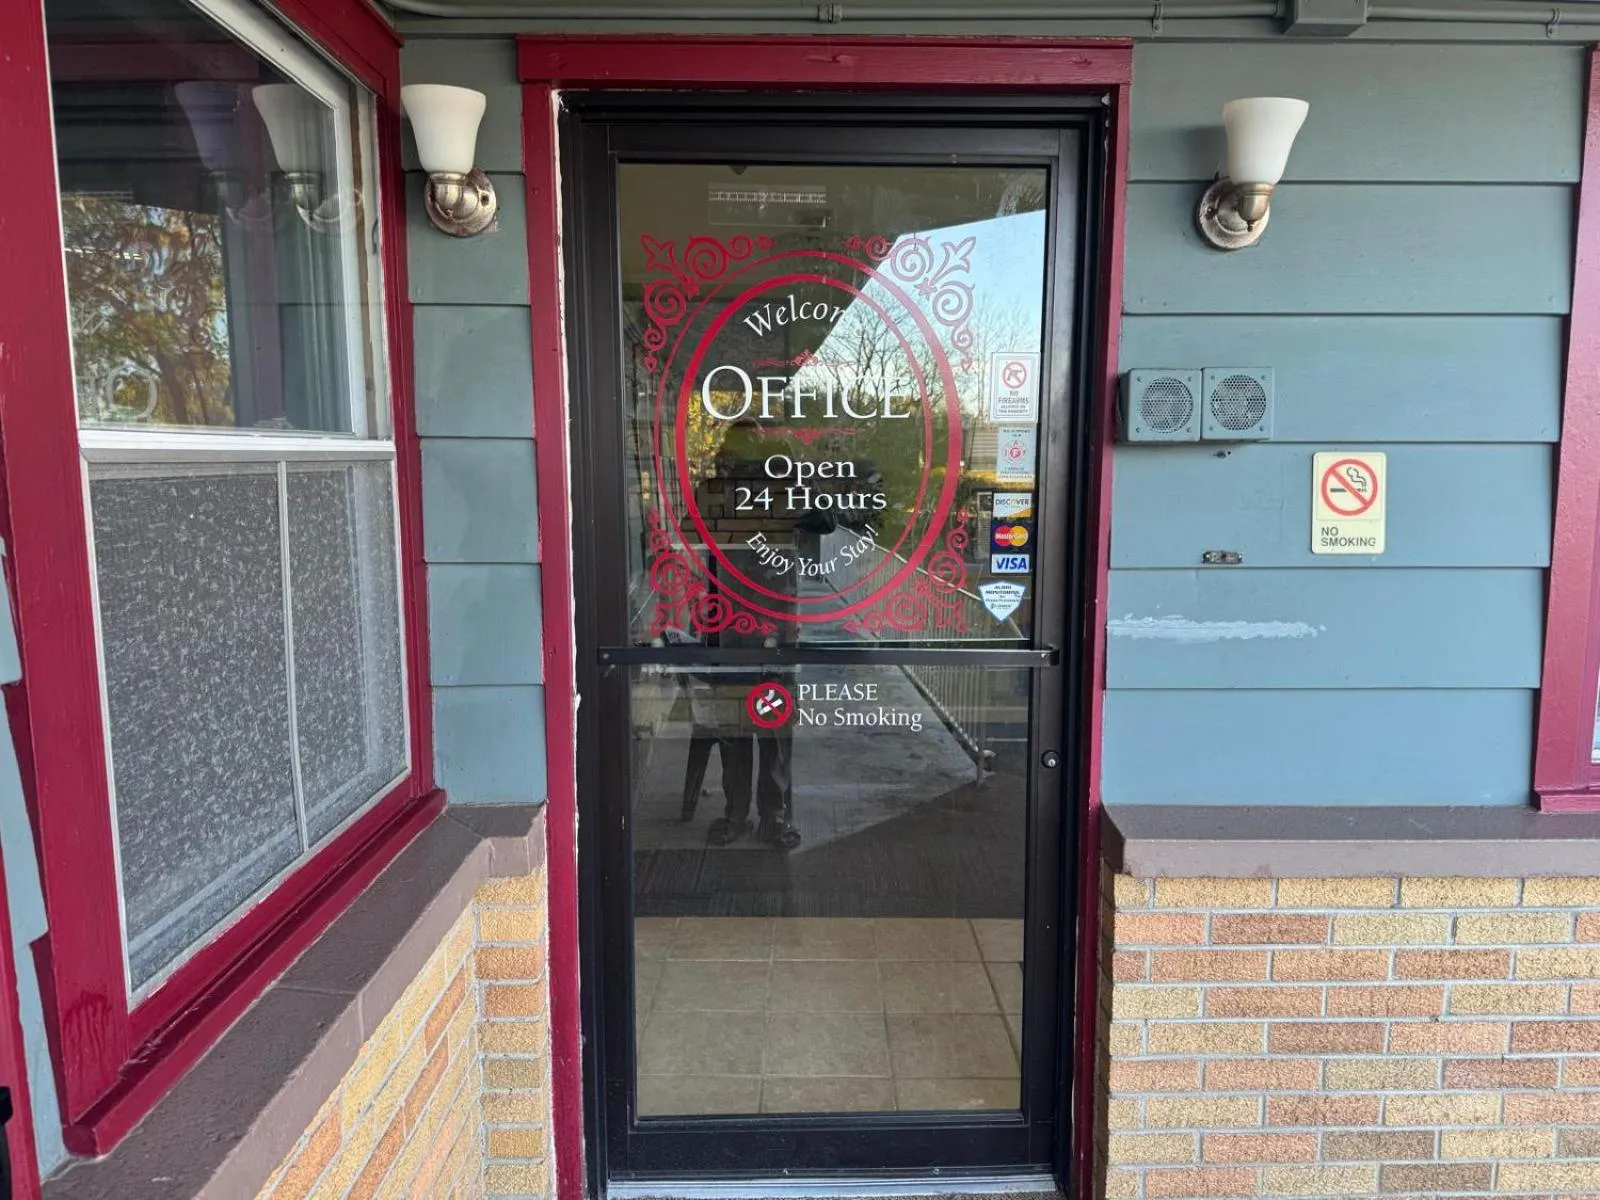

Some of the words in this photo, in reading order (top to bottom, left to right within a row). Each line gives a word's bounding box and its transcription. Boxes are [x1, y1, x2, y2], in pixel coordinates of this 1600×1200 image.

[743, 294, 848, 337] Welco
[702, 365, 910, 420] OFFICE
[998, 396, 1029, 405] FIREARMS
[764, 454, 857, 487] Open
[735, 486, 774, 511] 24
[785, 486, 887, 510] Hours
[995, 498, 1029, 506] DISCOVER
[1321, 526, 1339, 537] NO
[1321, 537, 1376, 547] SMOKING
[745, 531, 795, 576] Enjoy
[798, 557, 838, 577] Your
[840, 523, 879, 567] Stay!
[996, 557, 1028, 570] VISA
[798, 683, 878, 701] PLEASE
[798, 708, 828, 727] No
[833, 706, 923, 732] Smoking
